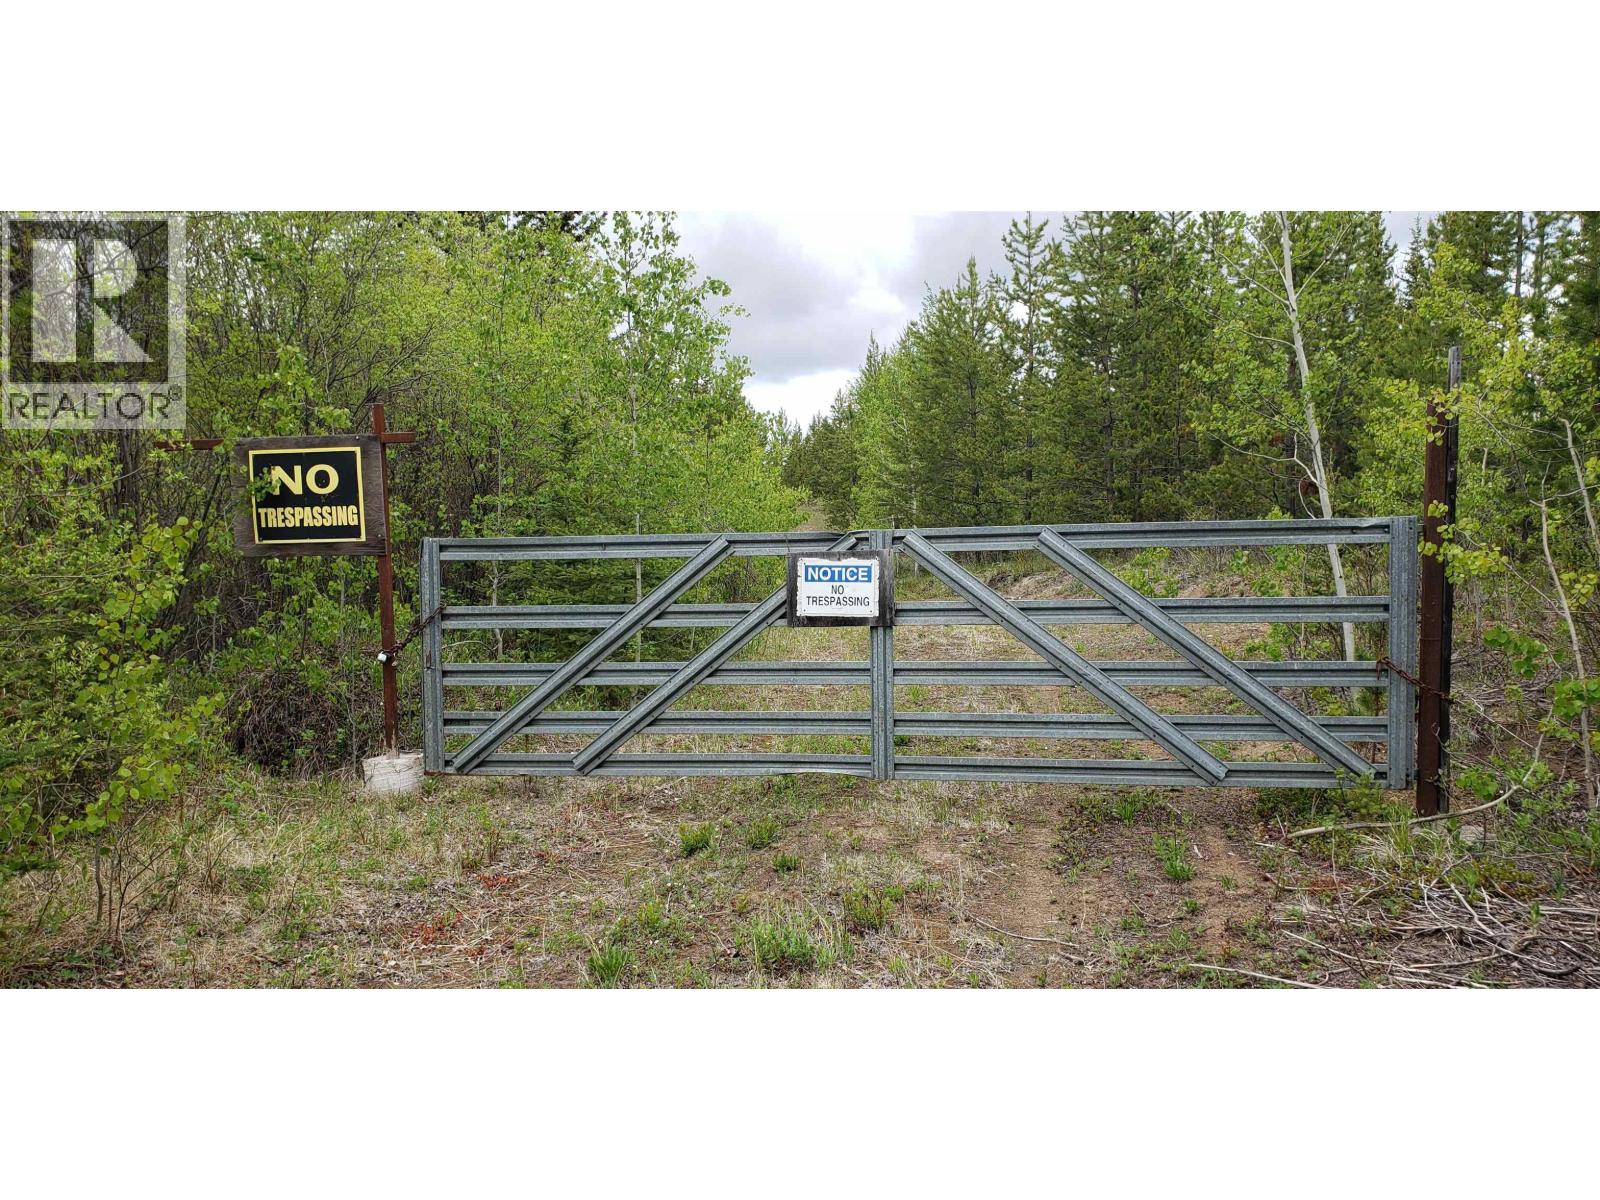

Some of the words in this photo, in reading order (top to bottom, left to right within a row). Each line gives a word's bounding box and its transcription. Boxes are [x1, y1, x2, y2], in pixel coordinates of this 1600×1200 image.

[270, 463, 339, 496] NO
[257, 504, 359, 528] TRESPASSING
[807, 566, 869, 582] NOTICE
[831, 584, 845, 595] NO
[806, 595, 870, 607] TRESPASSING
